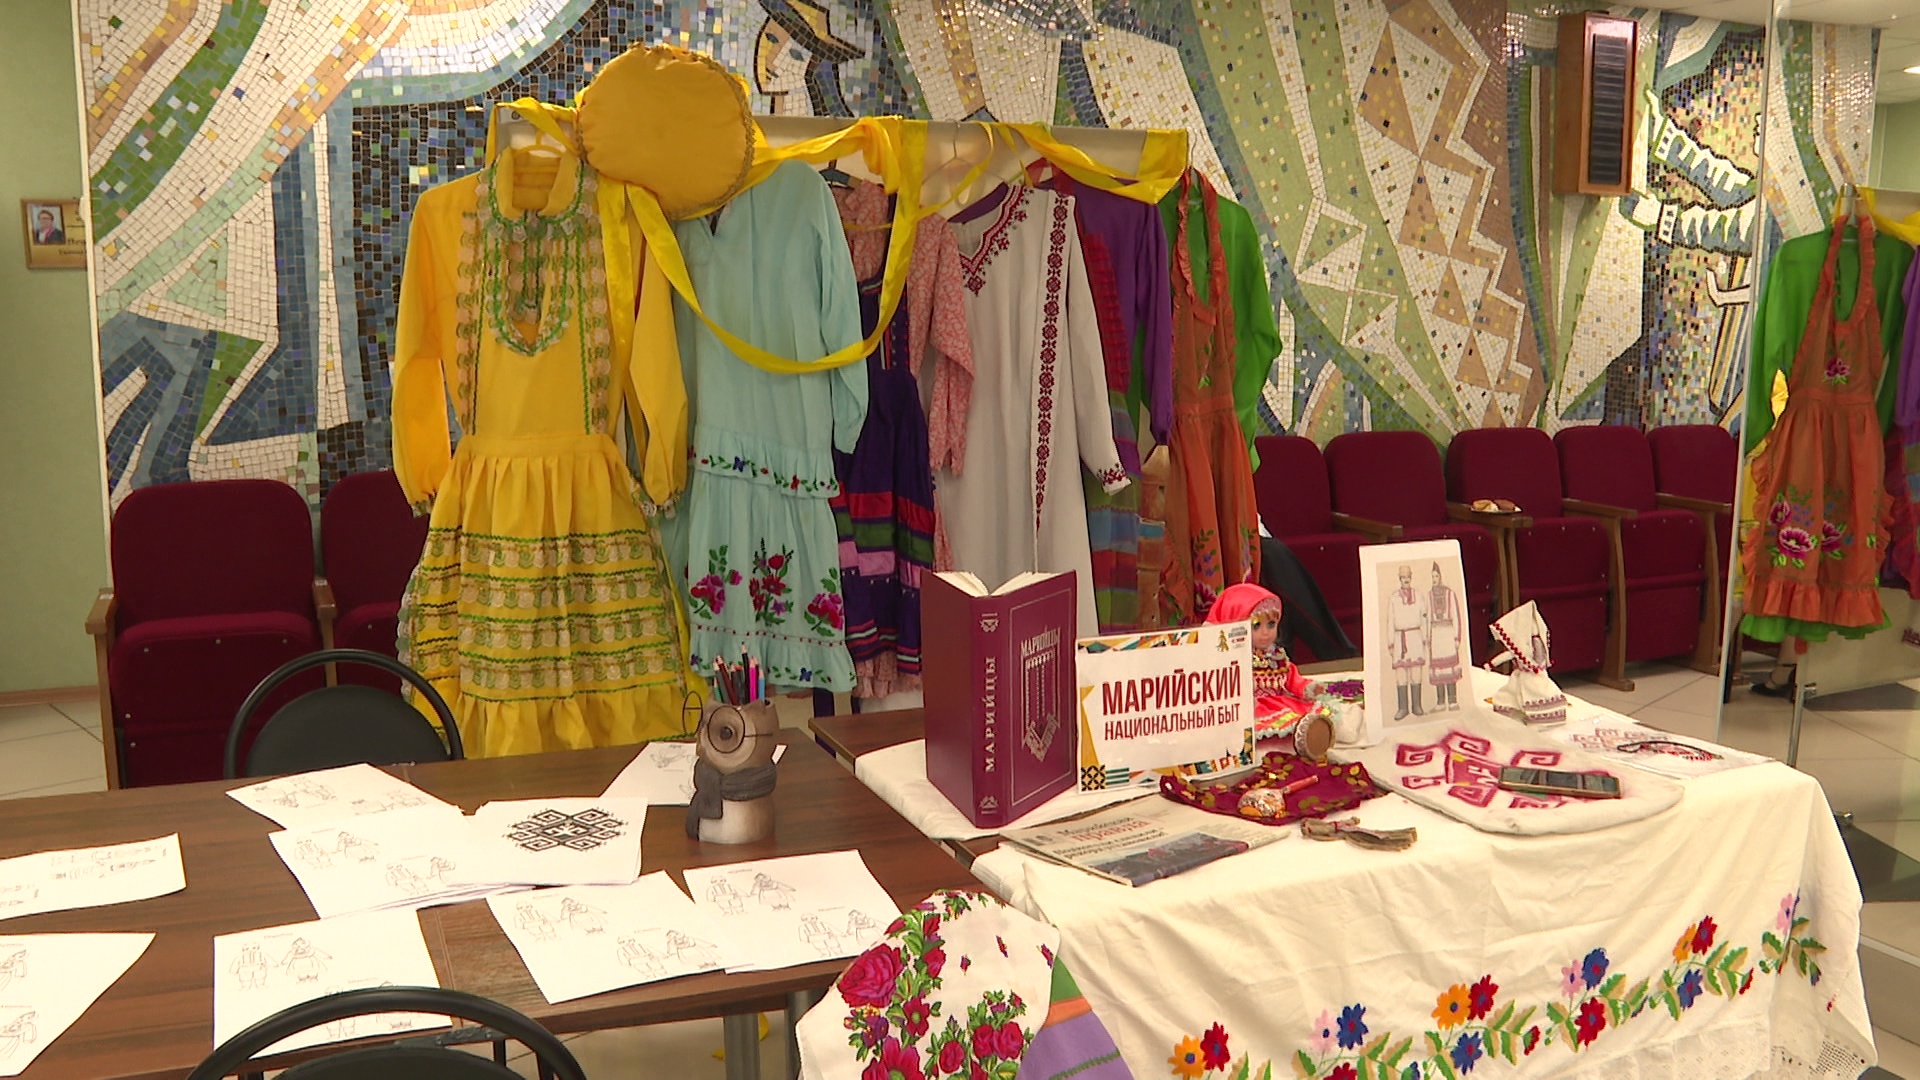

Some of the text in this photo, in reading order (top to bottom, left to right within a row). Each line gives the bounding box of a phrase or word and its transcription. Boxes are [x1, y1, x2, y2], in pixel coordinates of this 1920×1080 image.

[982, 657, 998, 772] МАРИЙЦЫ
[1102, 660, 1241, 716] МАРИЙСКИЙ
[1104, 703, 1240, 741] НАЦИОНАЛЬНЫЙ БЫТ
